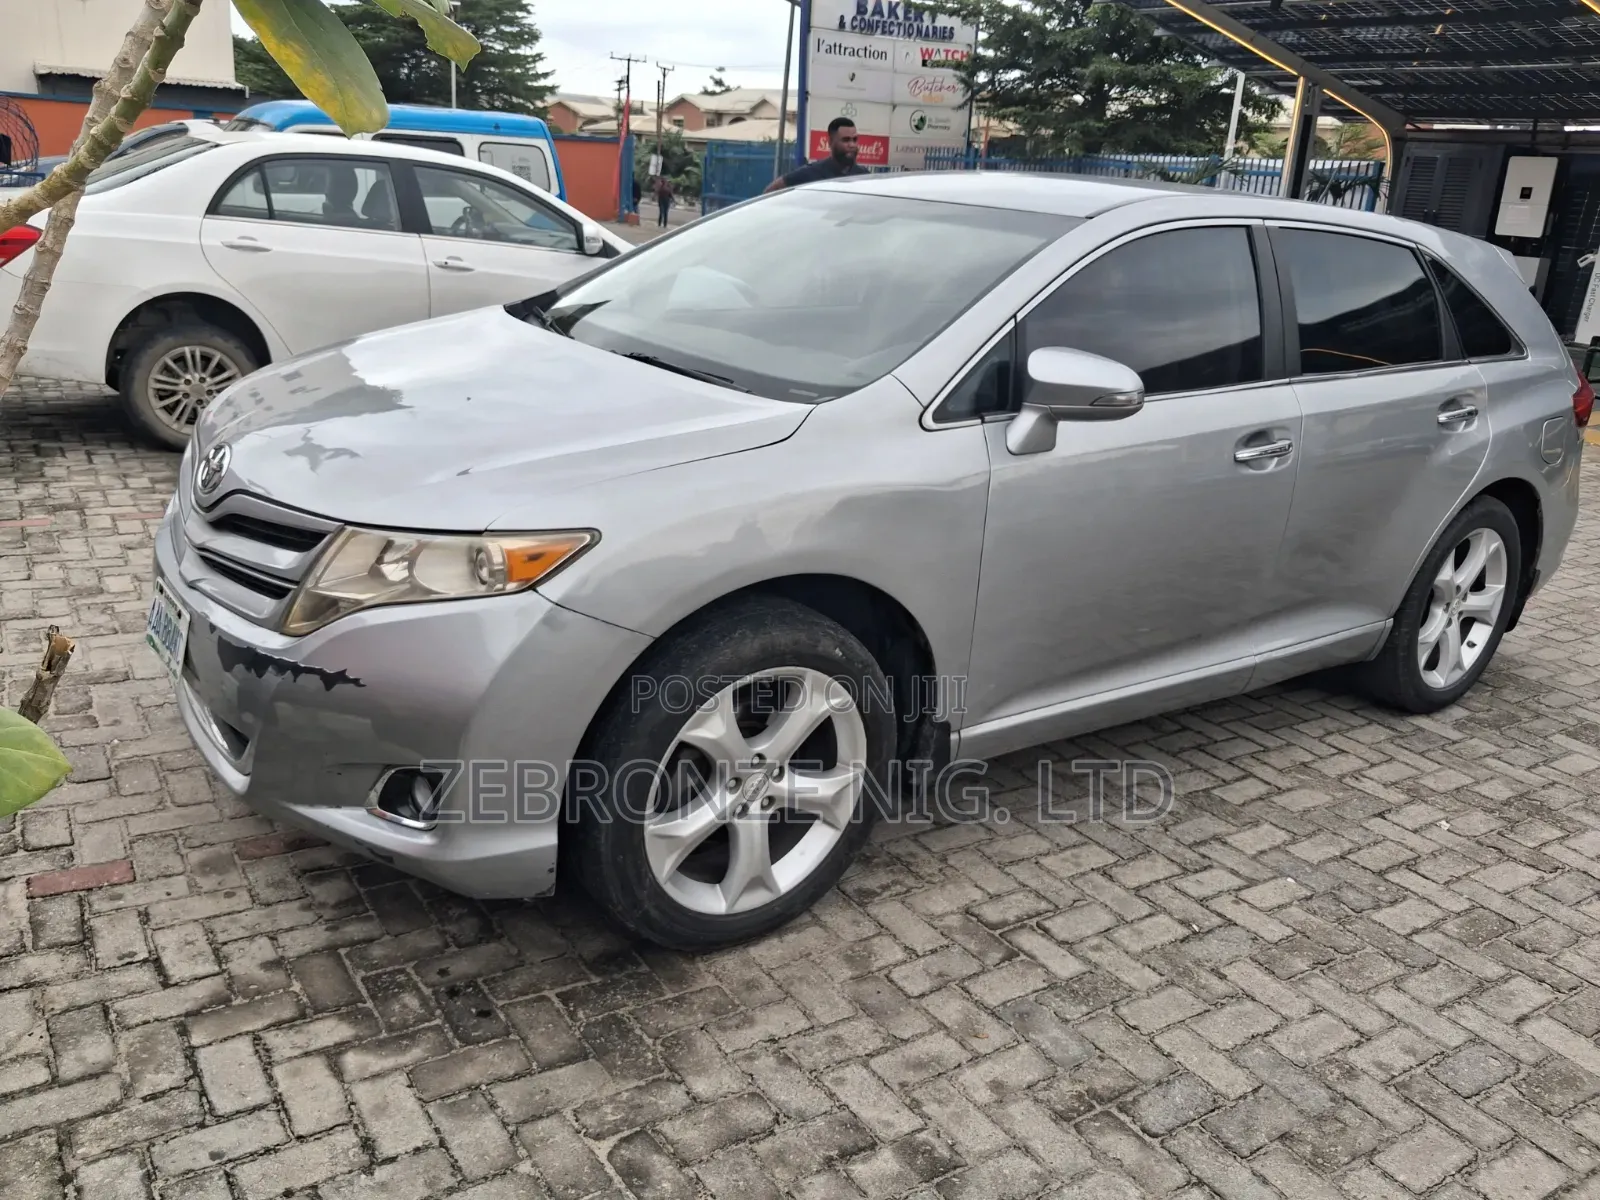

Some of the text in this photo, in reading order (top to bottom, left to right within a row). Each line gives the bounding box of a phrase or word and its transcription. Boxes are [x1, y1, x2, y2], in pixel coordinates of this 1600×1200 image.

[838, 15, 955, 40] & CONFECTIONARIES
[817, 38, 888, 61] l'attraction
[908, 76, 959, 97] Butcher
